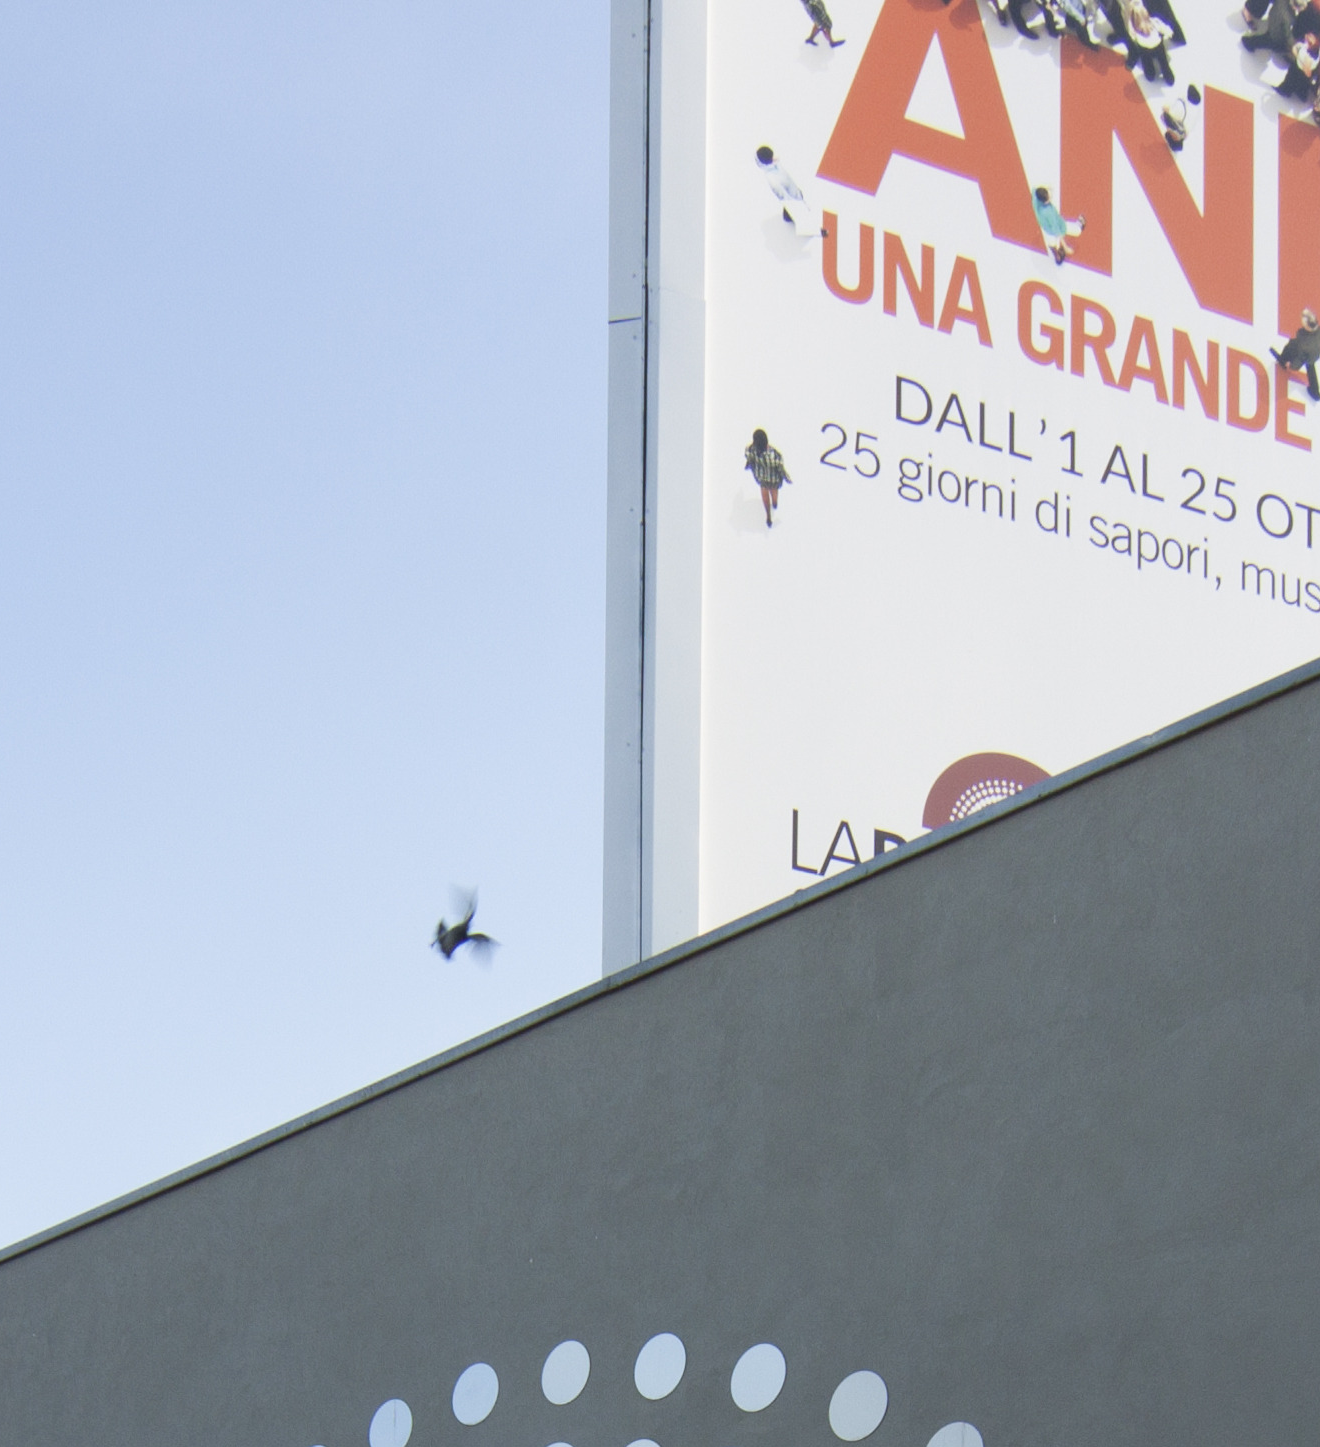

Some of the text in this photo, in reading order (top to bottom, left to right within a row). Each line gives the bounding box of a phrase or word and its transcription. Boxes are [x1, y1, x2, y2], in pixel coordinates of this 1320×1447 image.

[822, 209, 993, 348] UNA
[1017, 280, 1312, 452] GRANDE
[819, 422, 881, 478] 25
[897, 452, 1016, 521] giorni
[1035, 491, 1071, 538] di
[1089, 514, 1221, 591] sapori,
[1100, 444, 1165, 503] AL
[1179, 467, 1237, 522] 25
